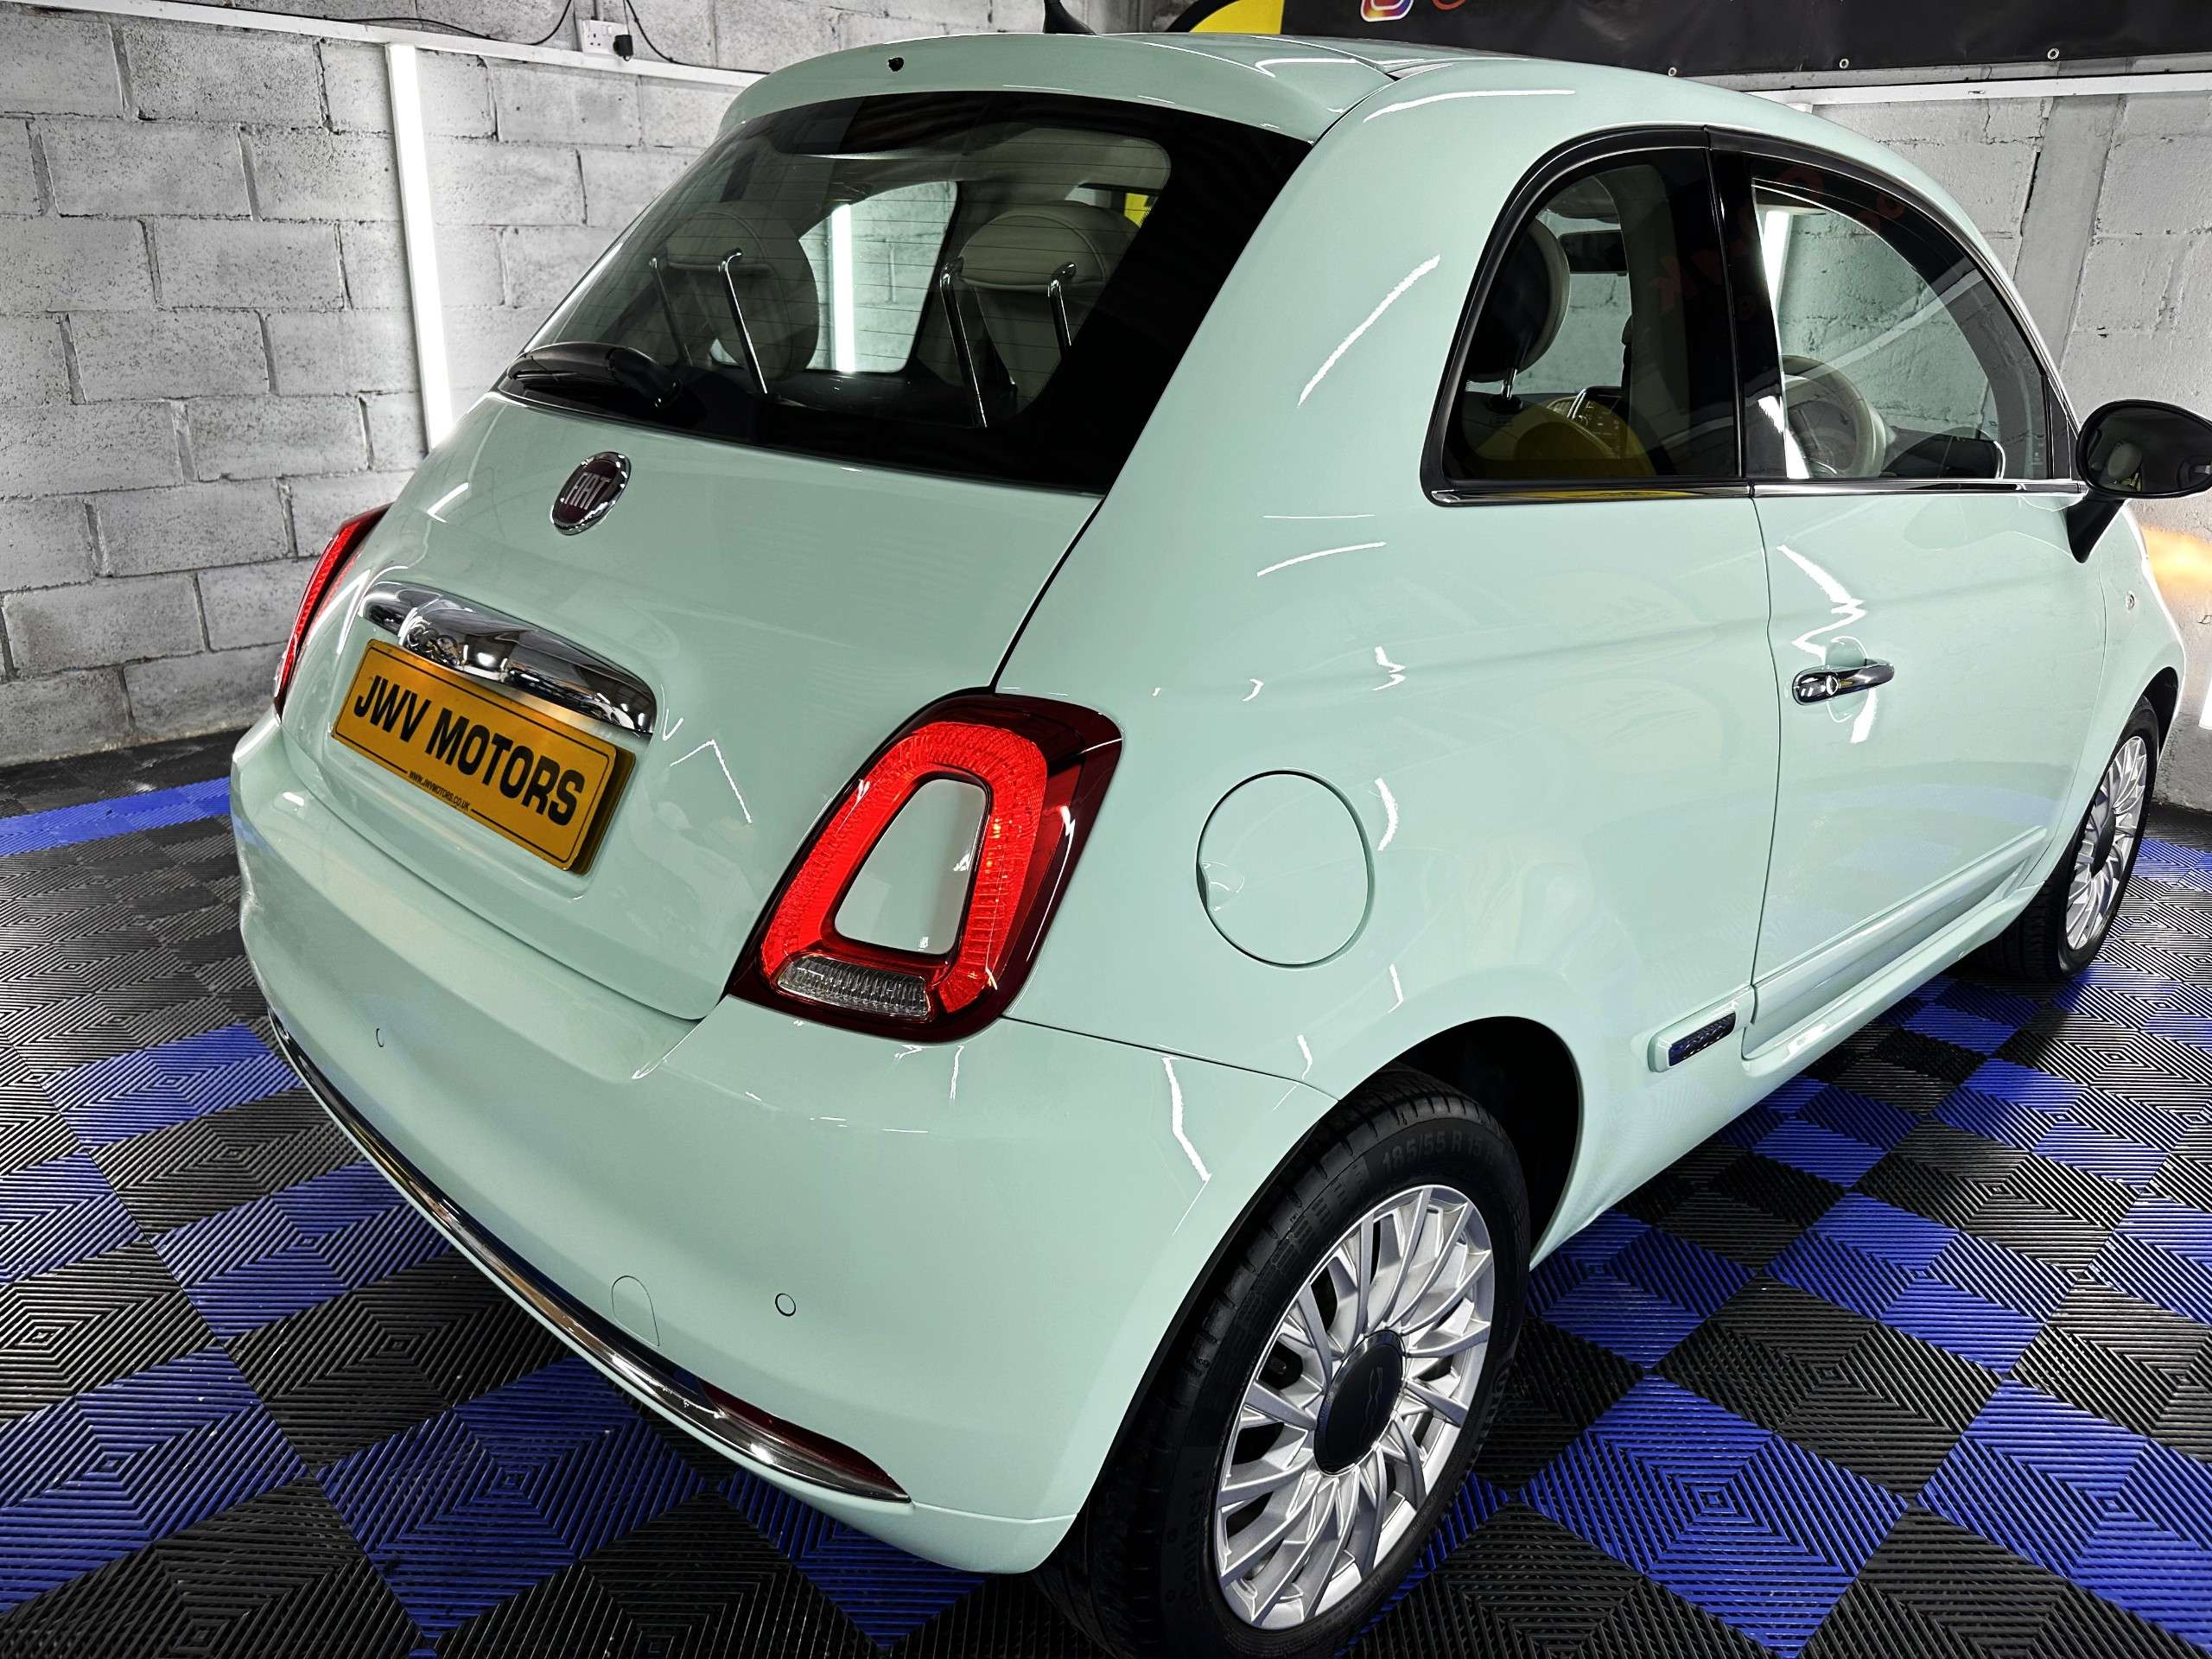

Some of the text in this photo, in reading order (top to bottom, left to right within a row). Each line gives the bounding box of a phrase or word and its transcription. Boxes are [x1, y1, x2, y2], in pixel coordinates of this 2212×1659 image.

[564, 472, 612, 510] FIAT
[353, 674, 586, 826] JWV MOTORS
[408, 770, 471, 811] WWW.JWVMOTORS.CO.UK
